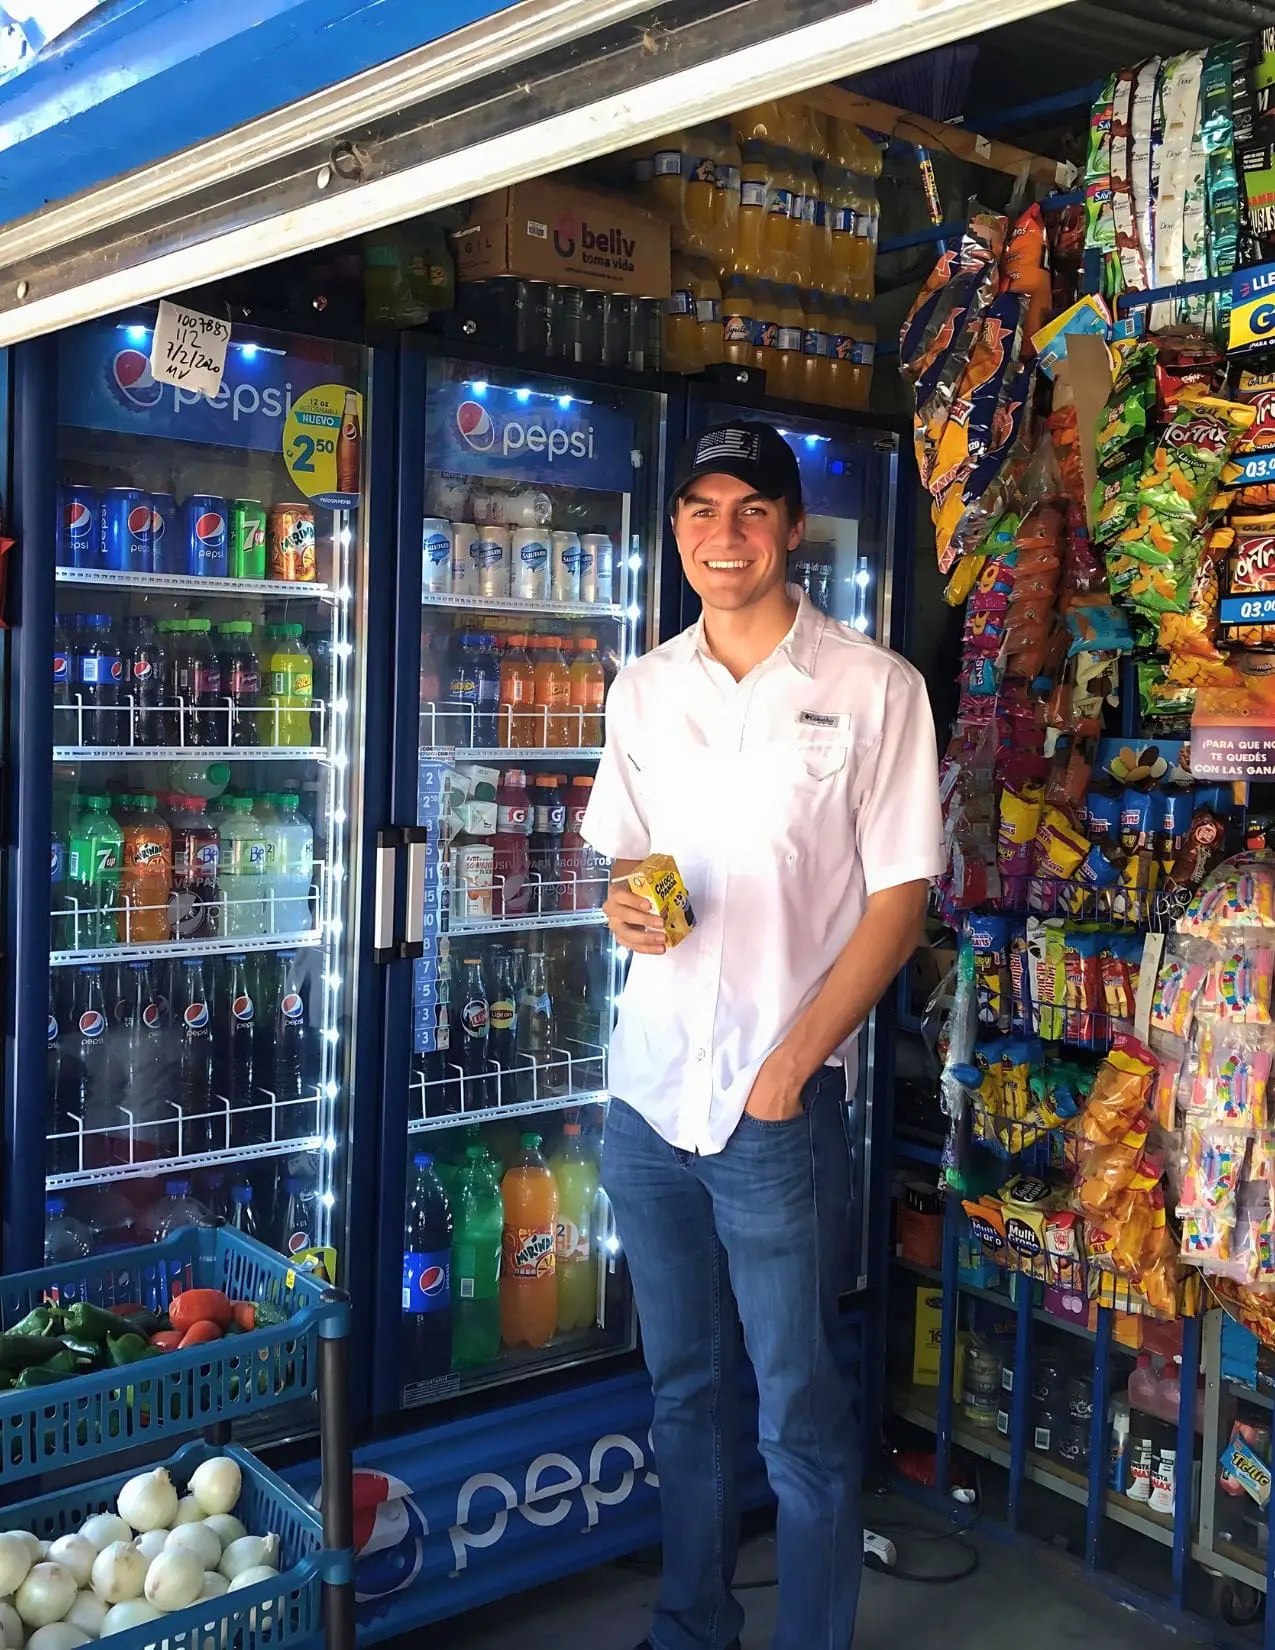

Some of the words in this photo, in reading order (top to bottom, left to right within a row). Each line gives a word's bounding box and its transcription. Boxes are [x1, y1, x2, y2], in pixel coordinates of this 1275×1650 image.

[582, 221, 636, 257] beliv
[582, 251, 611, 268] toma
[611, 258, 635, 273] vida
[1252, 270, 1275, 291] LLE
[302, 414, 335, 426] NUEVO
[502, 426, 594, 462] pepsi
[292, 434, 316, 473] 2
[315, 438, 335, 454] 50
[198, 549, 224, 560] pepsi
[1202, 739, 1234, 750] ¡PARA
[1238, 740, 1260, 750] QUE
[1211, 752, 1223, 762] TE
[1226, 750, 1267, 763] QUEDÉS
[1193, 764, 1220, 775] CON
[1222, 765, 1243, 776] LAS
[513, 809, 526, 823] G
[551, 808, 562, 822] G
[422, 983, 431, 997] 5
[422, 1007, 430, 1021] 3
[490, 1010, 513, 1020] Lipton
[422, 1031, 430, 1045] 3
[1008, 1224, 1036, 1241] Multi
